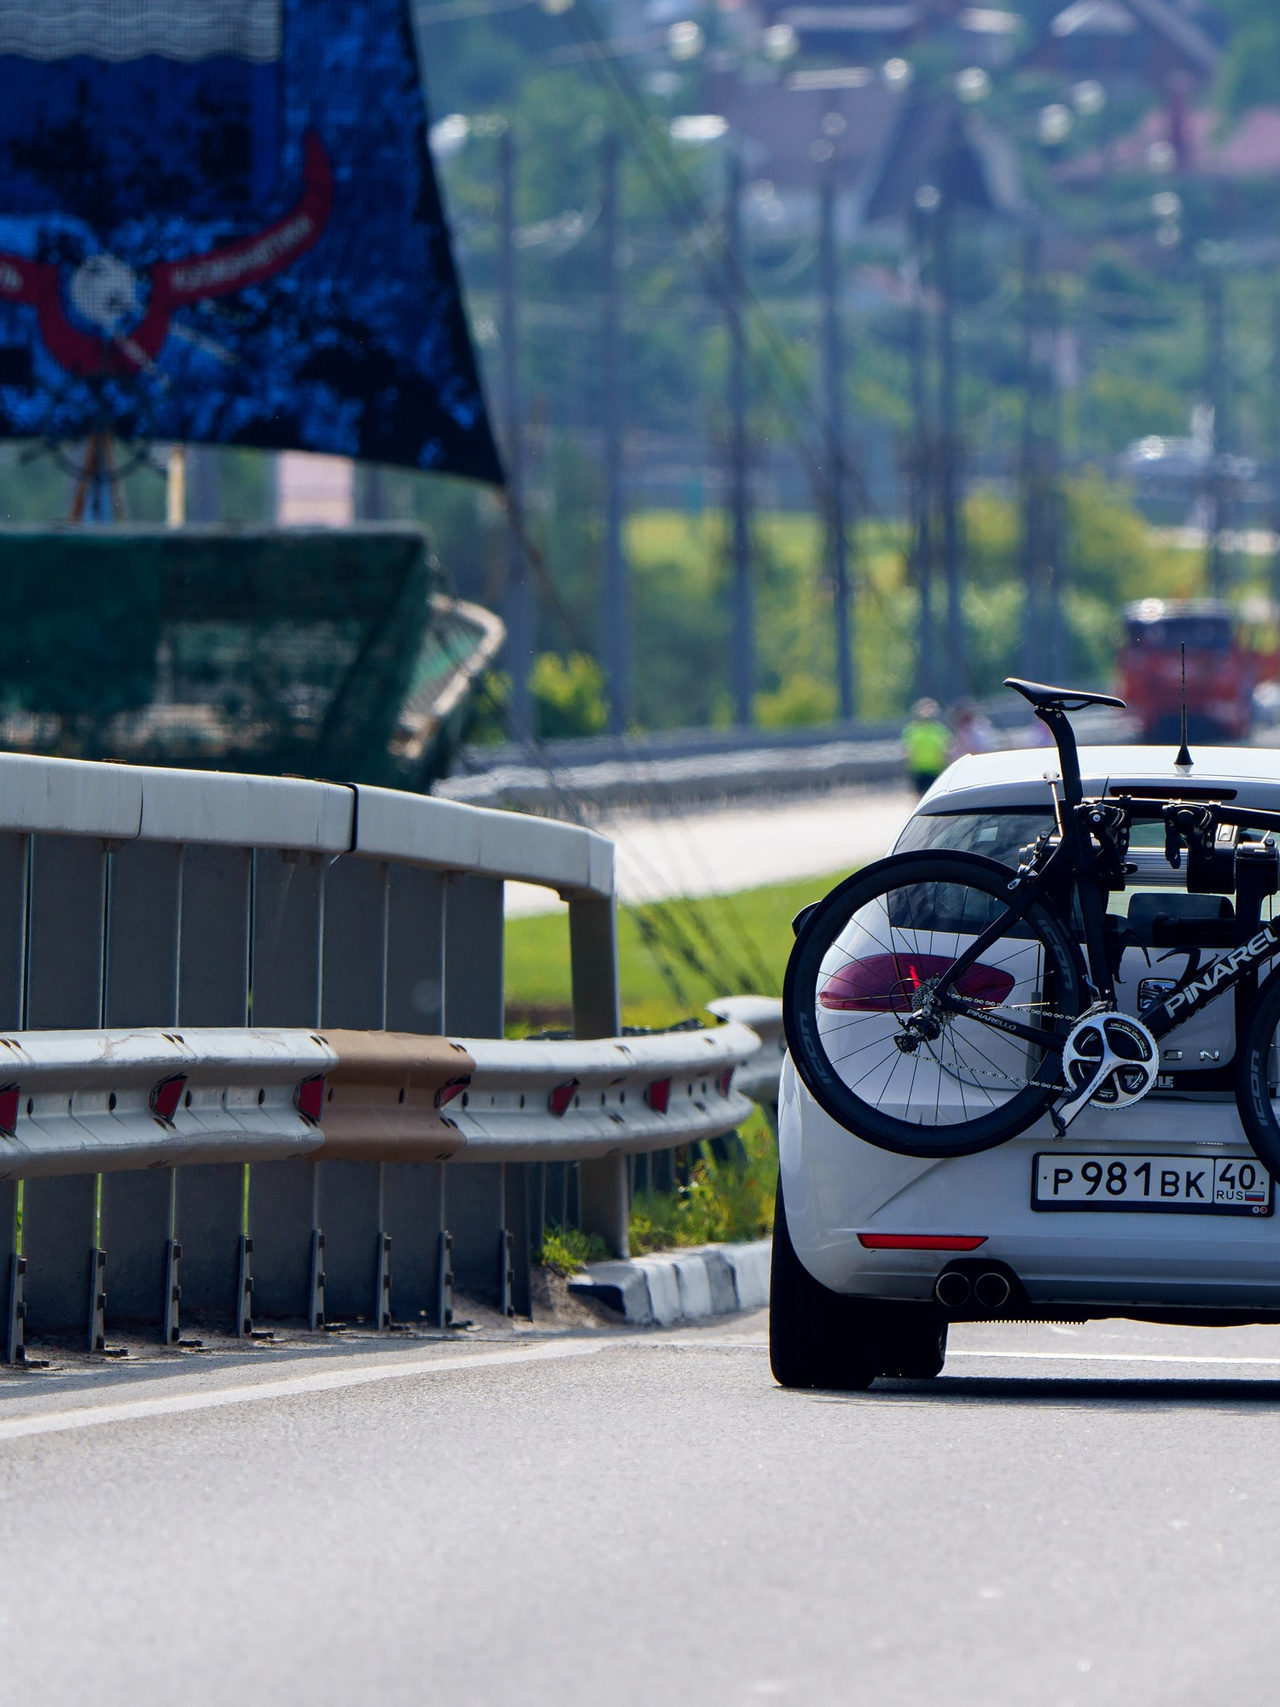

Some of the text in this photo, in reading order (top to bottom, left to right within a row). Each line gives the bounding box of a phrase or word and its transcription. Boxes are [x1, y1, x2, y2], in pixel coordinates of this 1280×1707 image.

[966, 1008, 1017, 1031] PINARELLO
[1218, 1163, 1256, 1190] 40
[1216, 1190, 1244, 1201] RUS
